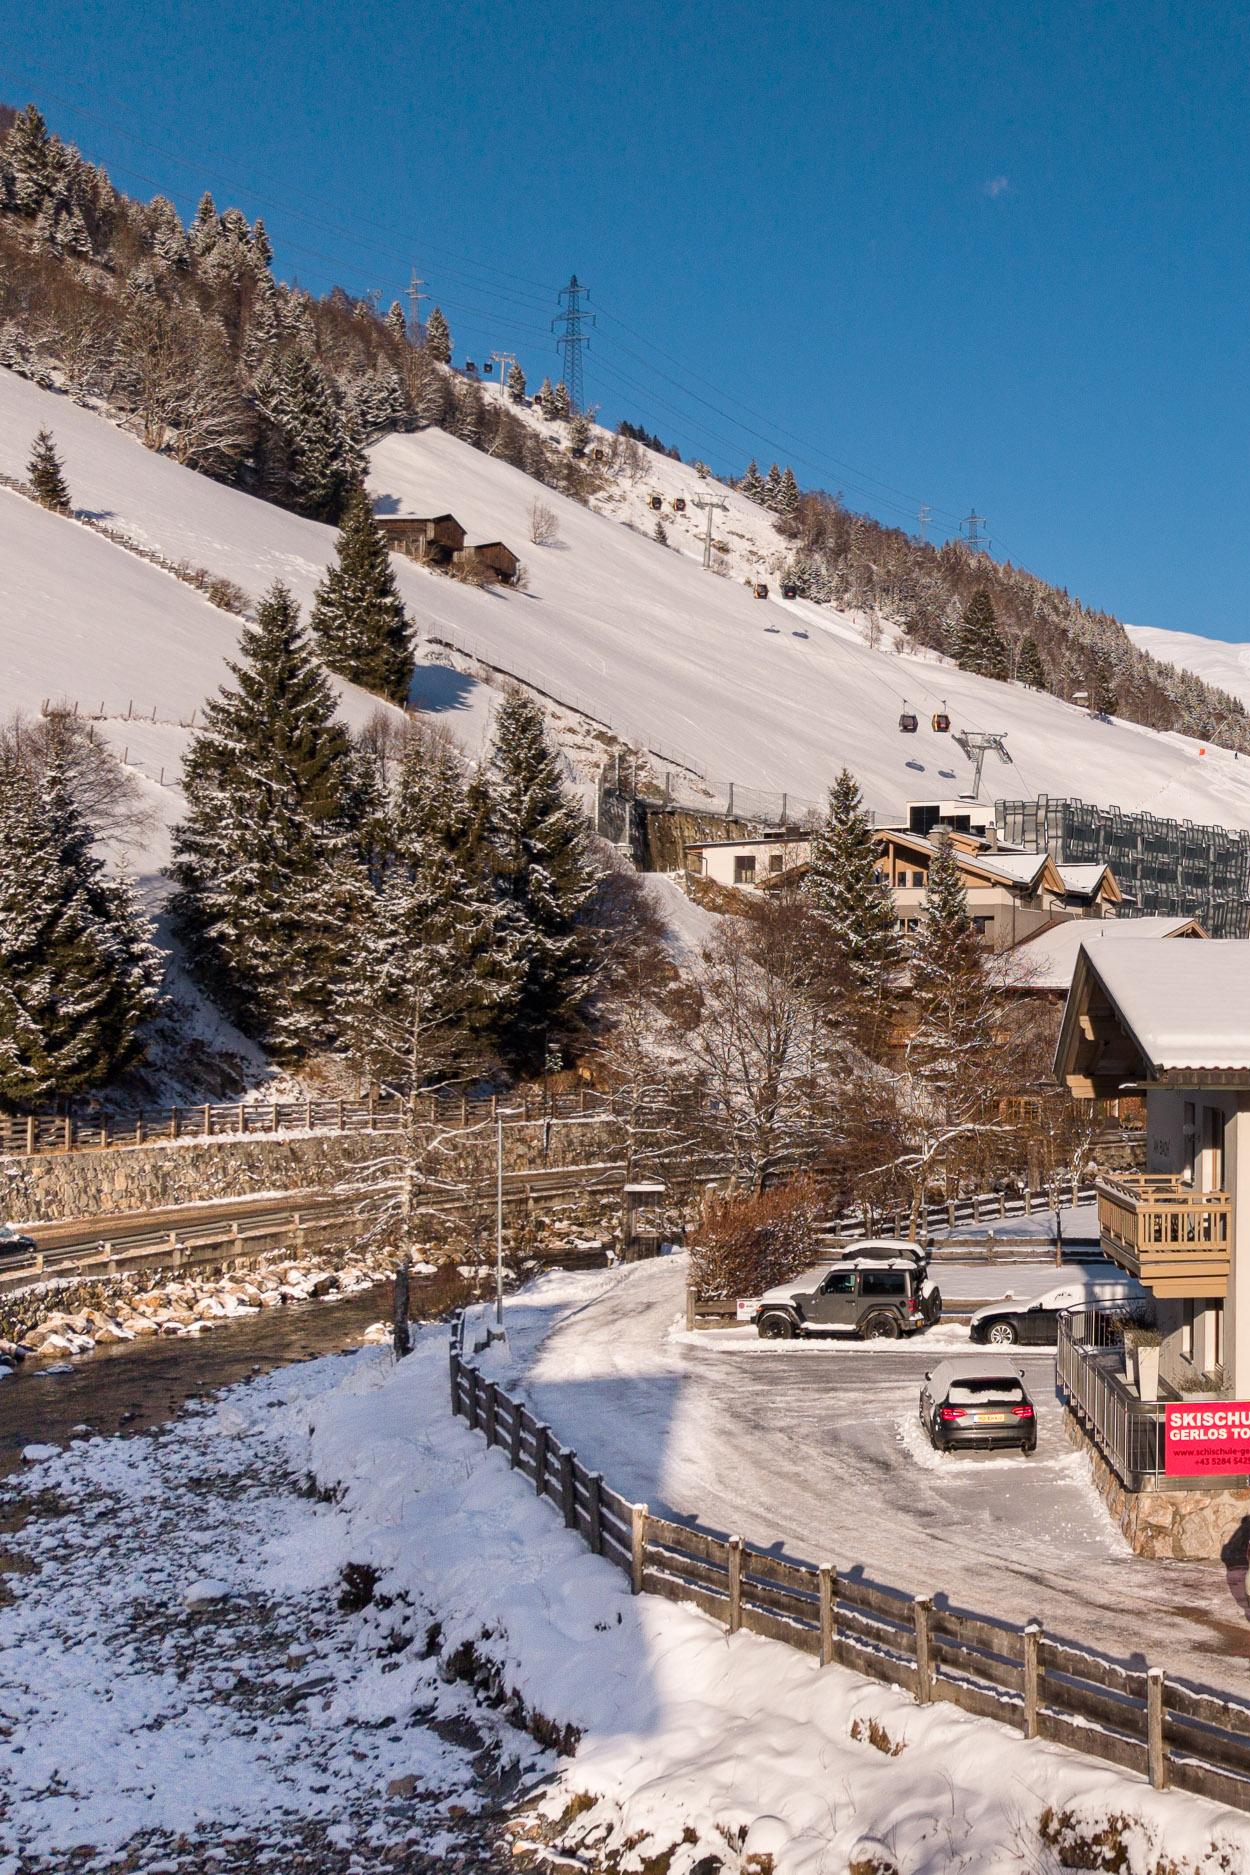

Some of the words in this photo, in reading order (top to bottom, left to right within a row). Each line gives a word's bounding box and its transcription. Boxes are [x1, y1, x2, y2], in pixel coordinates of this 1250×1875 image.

[1169, 1428, 1227, 1440] GERLOS
[1195, 1457, 1210, 1466] +43
[1211, 1457, 1231, 1466] 5284
